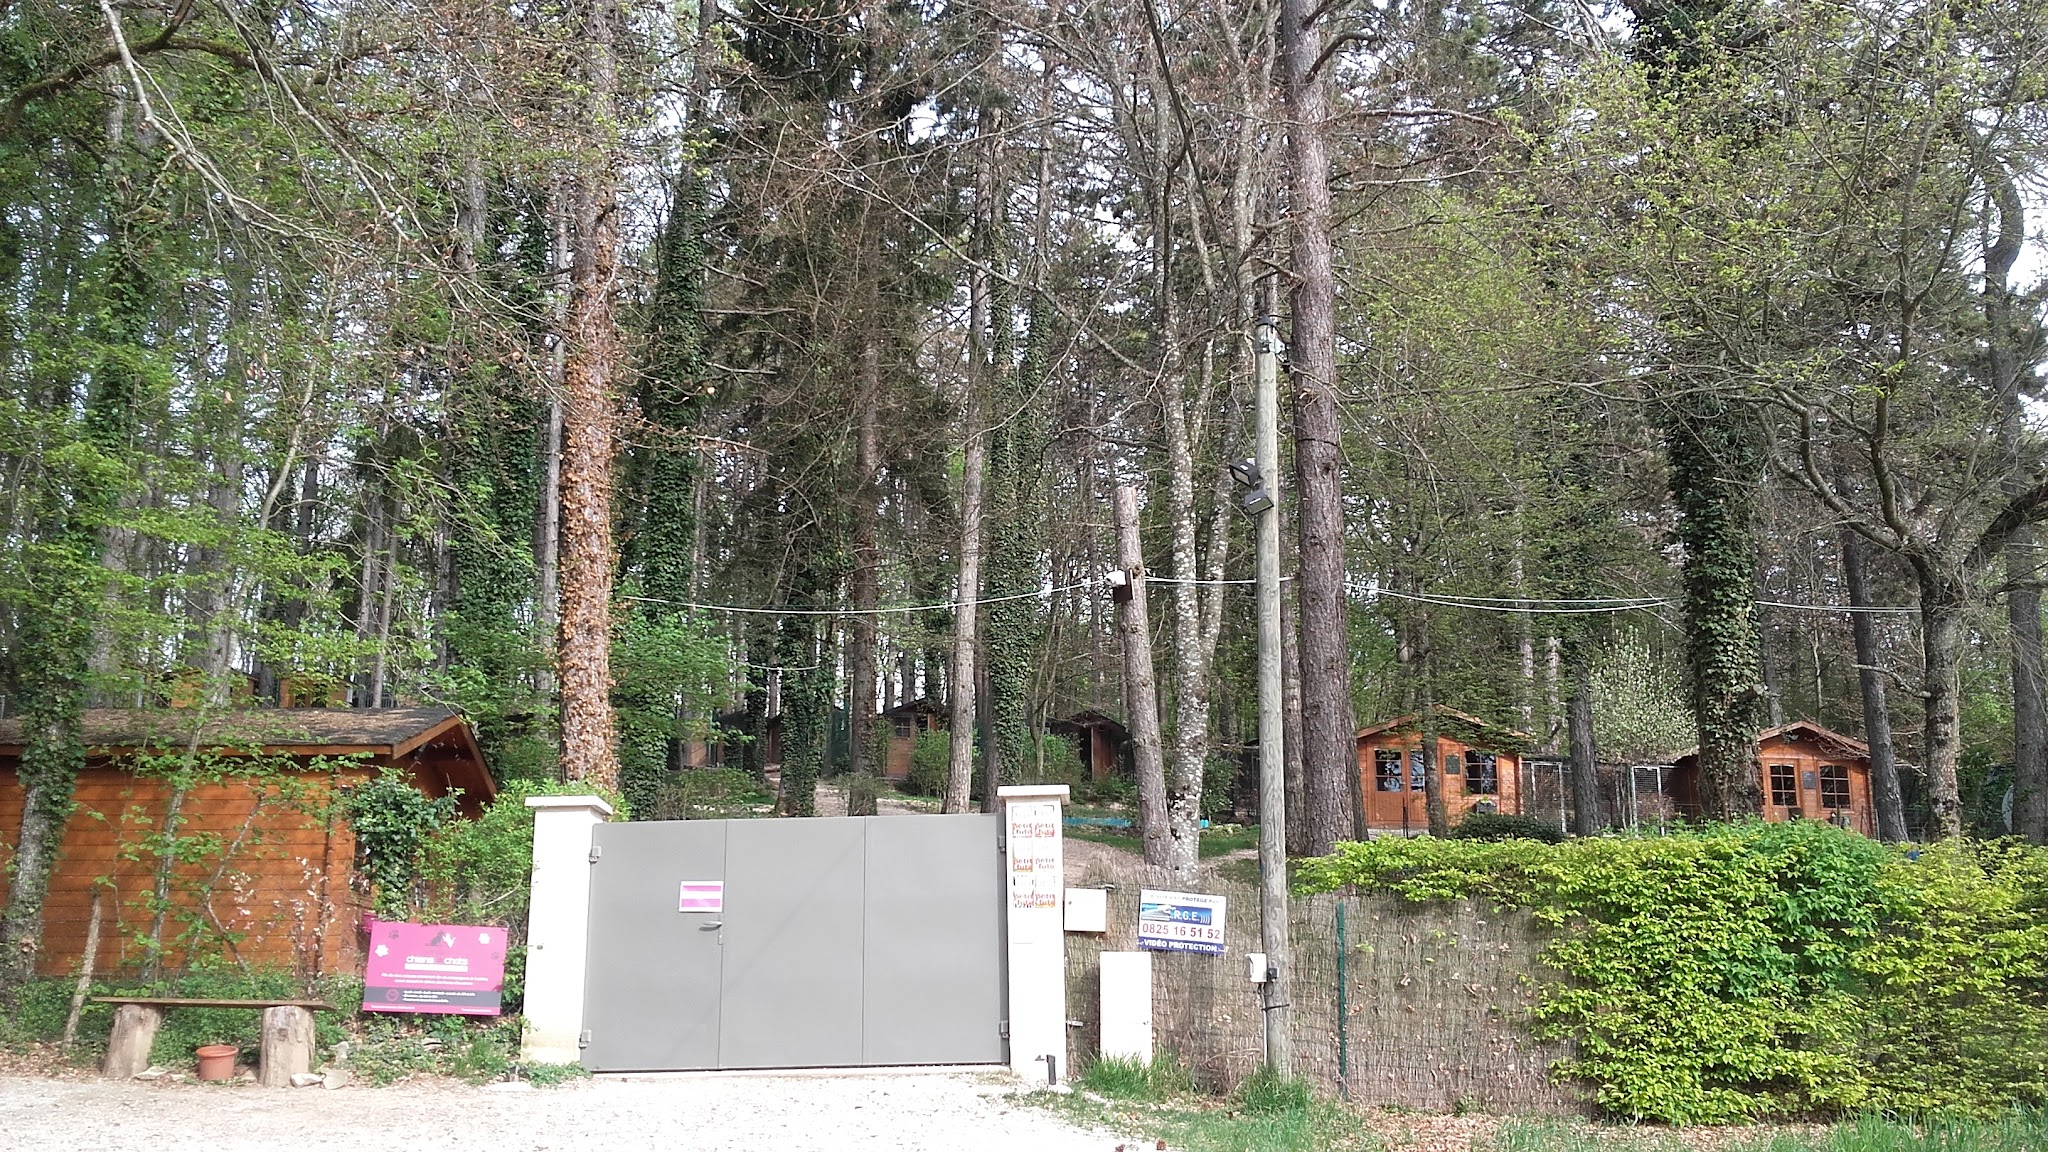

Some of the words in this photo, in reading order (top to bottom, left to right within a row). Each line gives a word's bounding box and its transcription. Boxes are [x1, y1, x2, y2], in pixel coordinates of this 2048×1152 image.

[1142, 923, 1169, 935] 0825
[1174, 926, 1186, 936] 16
[1190, 927, 1203, 938] 51
[1207, 928, 1221, 939] 52
[1169, 941, 1217, 952] PROTECTION
